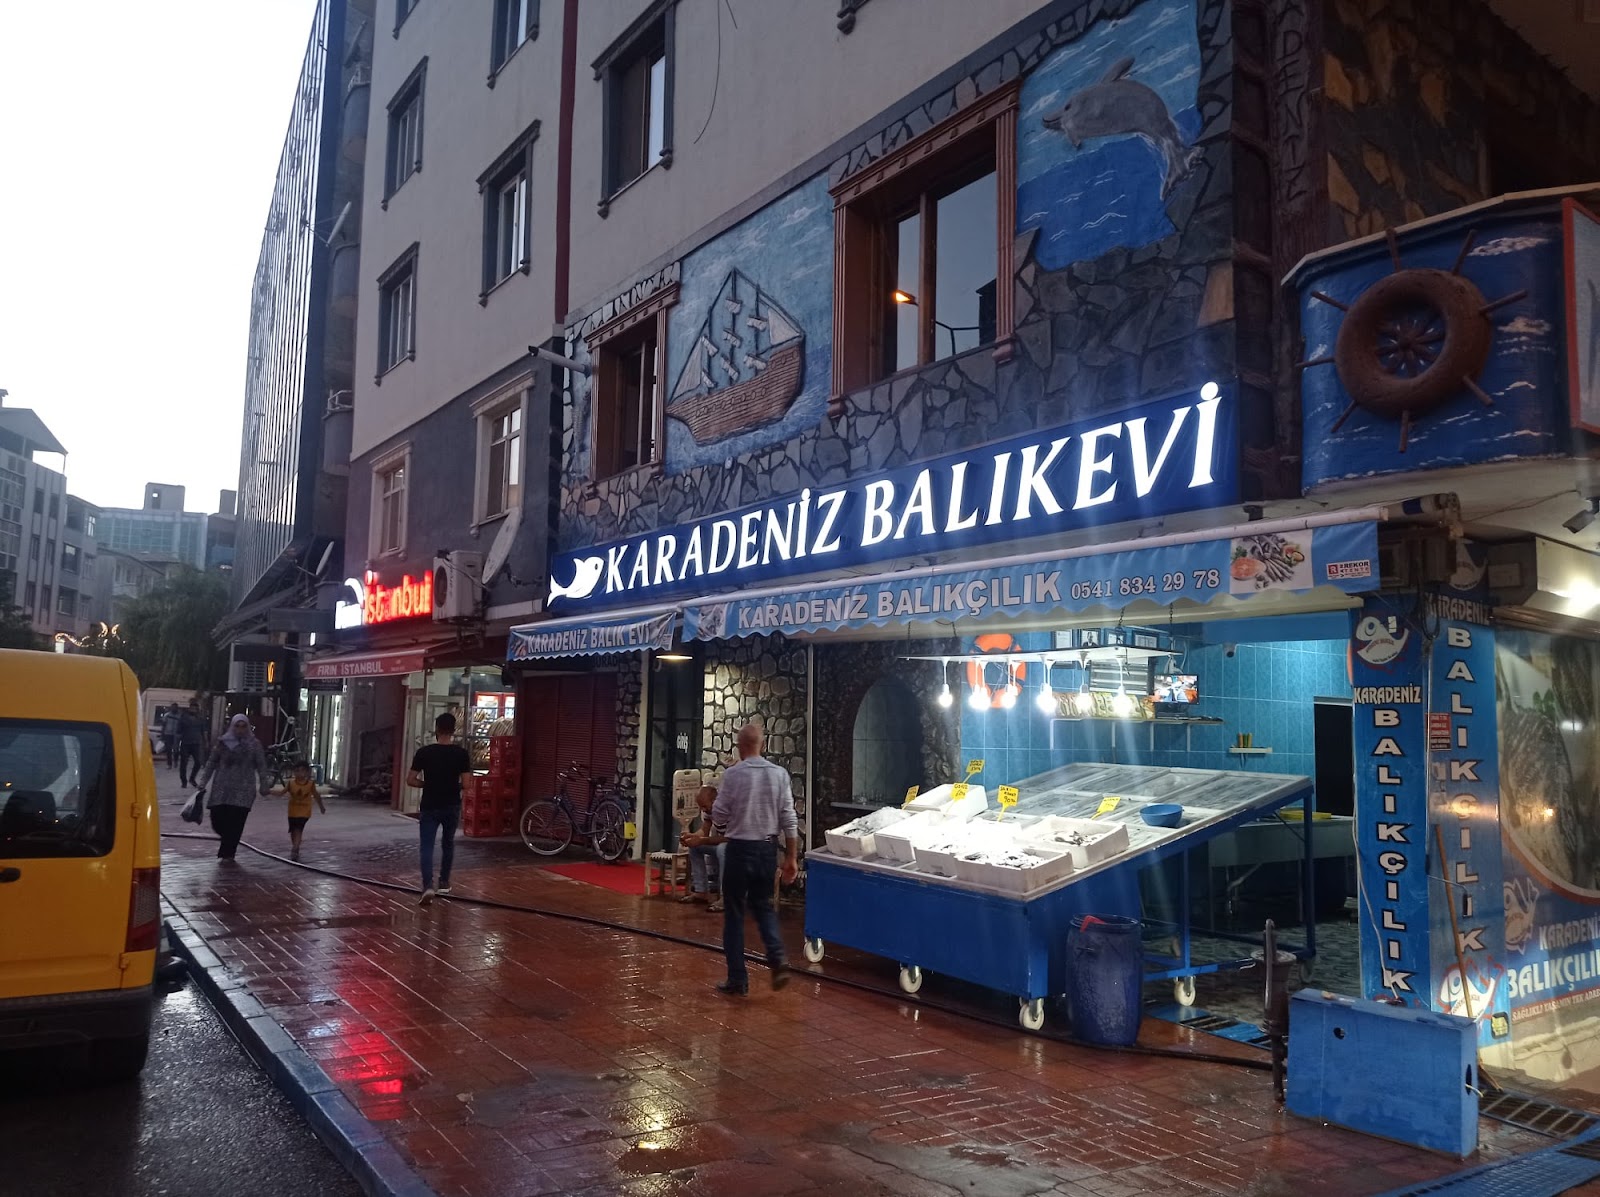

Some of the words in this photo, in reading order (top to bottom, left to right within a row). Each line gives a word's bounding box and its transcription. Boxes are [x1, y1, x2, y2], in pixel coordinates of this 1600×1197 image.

[605, 487, 848, 595] KARADENİZ
[859, 381, 1222, 548] BALIKEVİ
[737, 590, 869, 629] KARADENİZ
[877, 570, 1062, 617] BALIKÇILIK
[1071, 580, 1113, 600] 0541
[1119, 576, 1156, 596] 834
[1162, 572, 1186, 592] 29
[1193, 569, 1220, 589] 78
[527, 628, 588, 654] KARADENİZ
[590, 625, 626, 649] BALIK
[317, 664, 337, 676] FIRIN
[341, 660, 384, 676] İSTANBUL
[1353, 683, 1422, 705] KARADENİZ
[1373, 709, 1413, 992] BALIKÇILIK
[1539, 912, 1600, 951] KARADENİ
